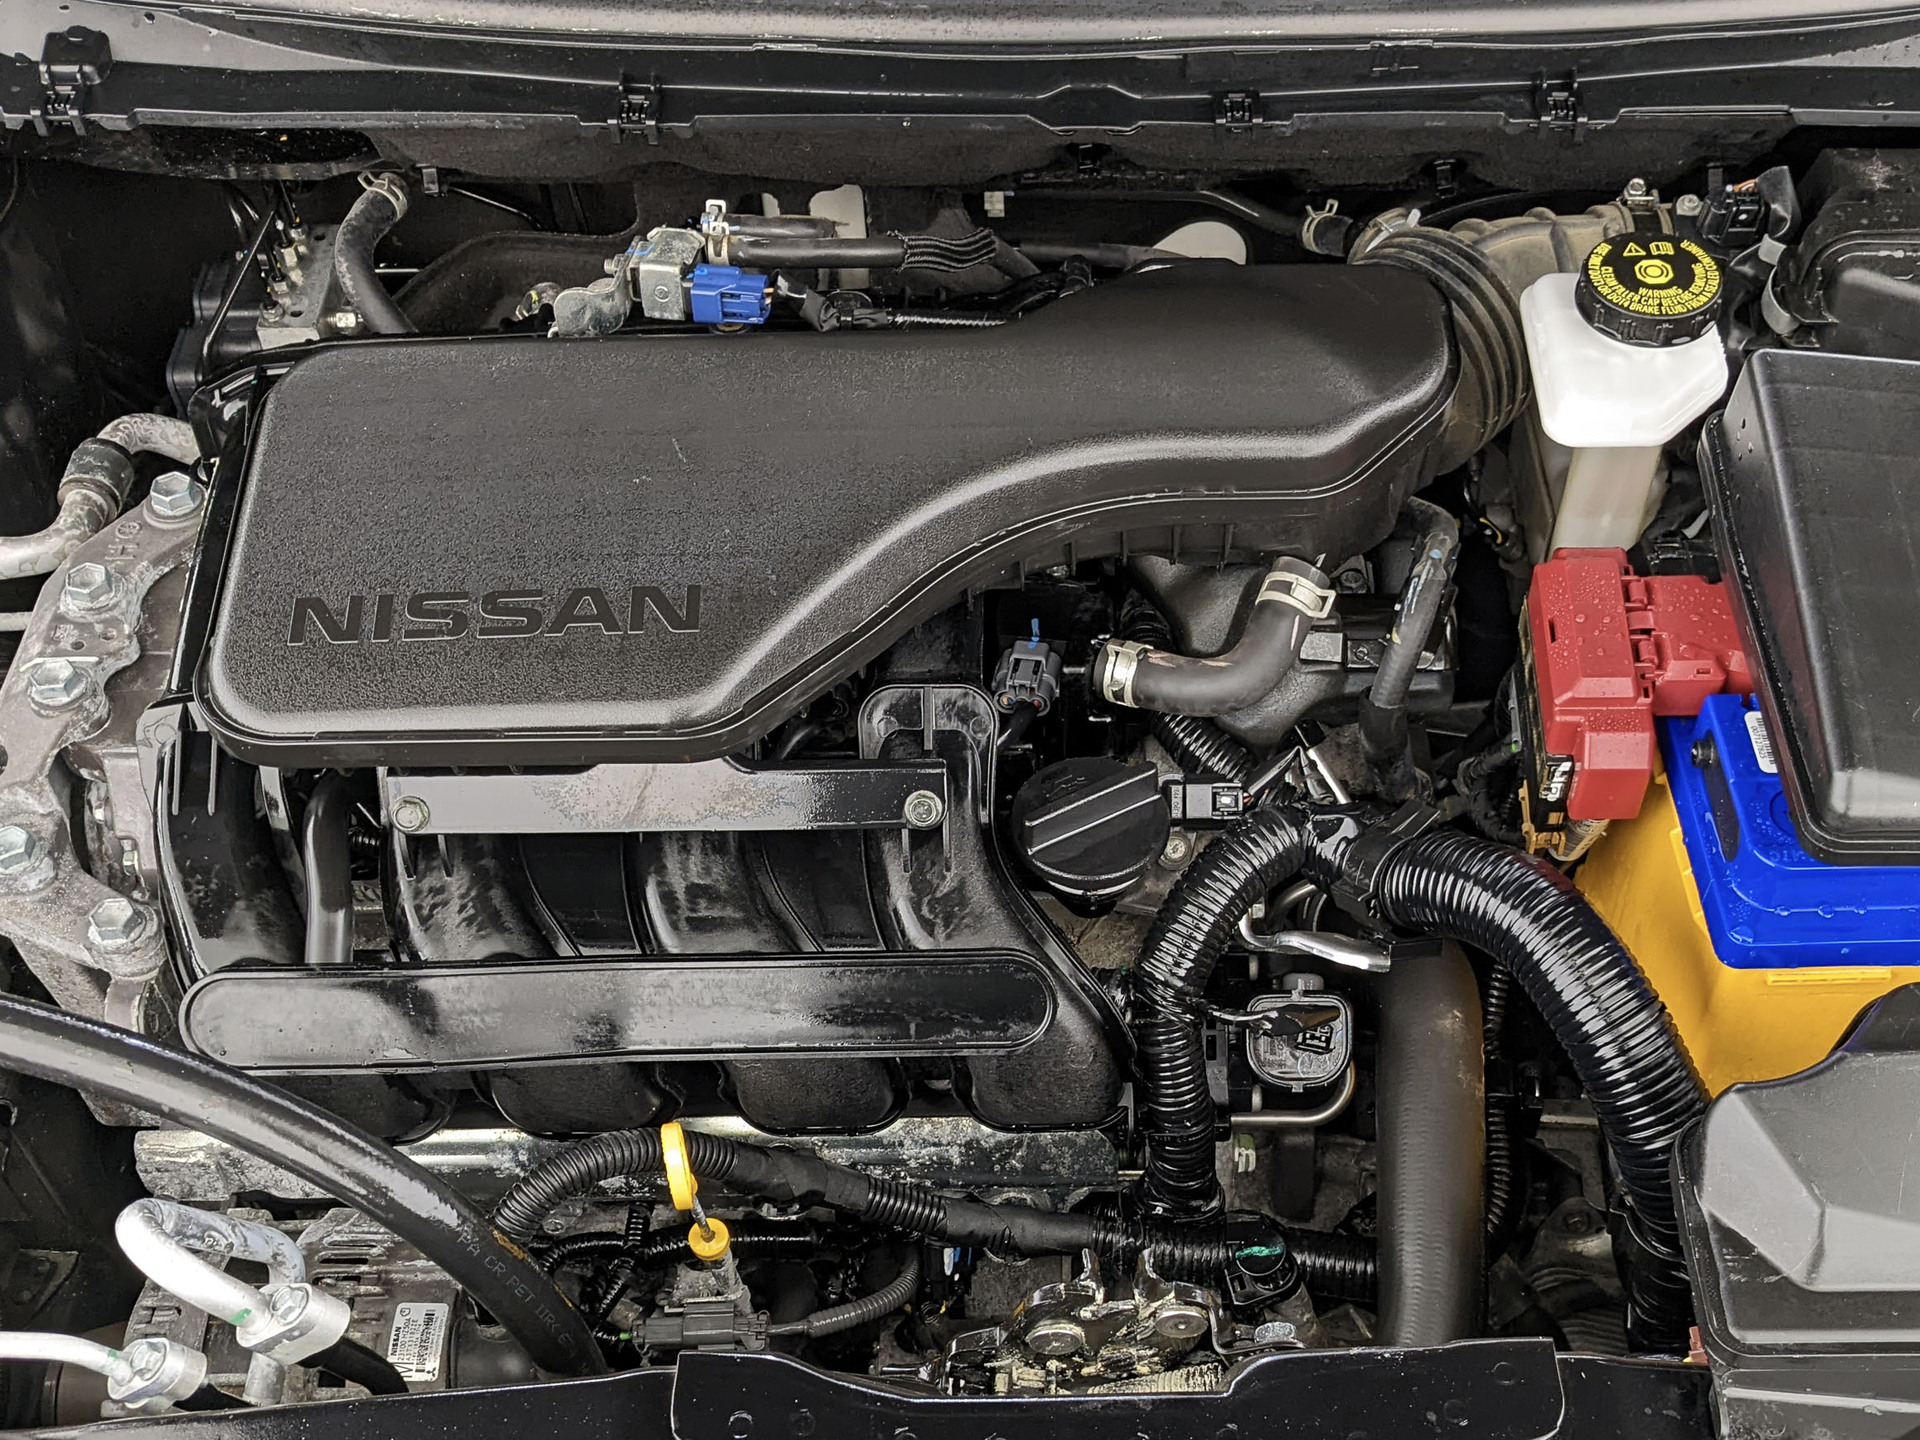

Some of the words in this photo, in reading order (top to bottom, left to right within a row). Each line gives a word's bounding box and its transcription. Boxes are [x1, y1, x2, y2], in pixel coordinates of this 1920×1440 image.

[1593, 243, 1612, 257] USE
[1680, 240, 1718, 271] CONTAINER
[1597, 284, 1612, 296] OR
[1601, 266, 1619, 288] CLEAN
[1616, 284, 1640, 302] FILLER
[1641, 295, 1660, 307] CAP
[1661, 290, 1694, 307] BEFORE
[1691, 262, 1707, 294] REMOVING
[1638, 286, 1683, 298] WARNING
[1706, 270, 1721, 294] SEALED
[1629, 302, 1660, 315] BRAKE
[1661, 302, 1688, 315] FLUID
[1685, 294, 1709, 311] FROM
[287, 584, 702, 646] NISSAN
[484, 1255, 507, 1277] CR
[506, 1275, 537, 1303] PET
[390, 1326, 402, 1356] NISSAN
[397, 1340, 407, 1361] 23100
